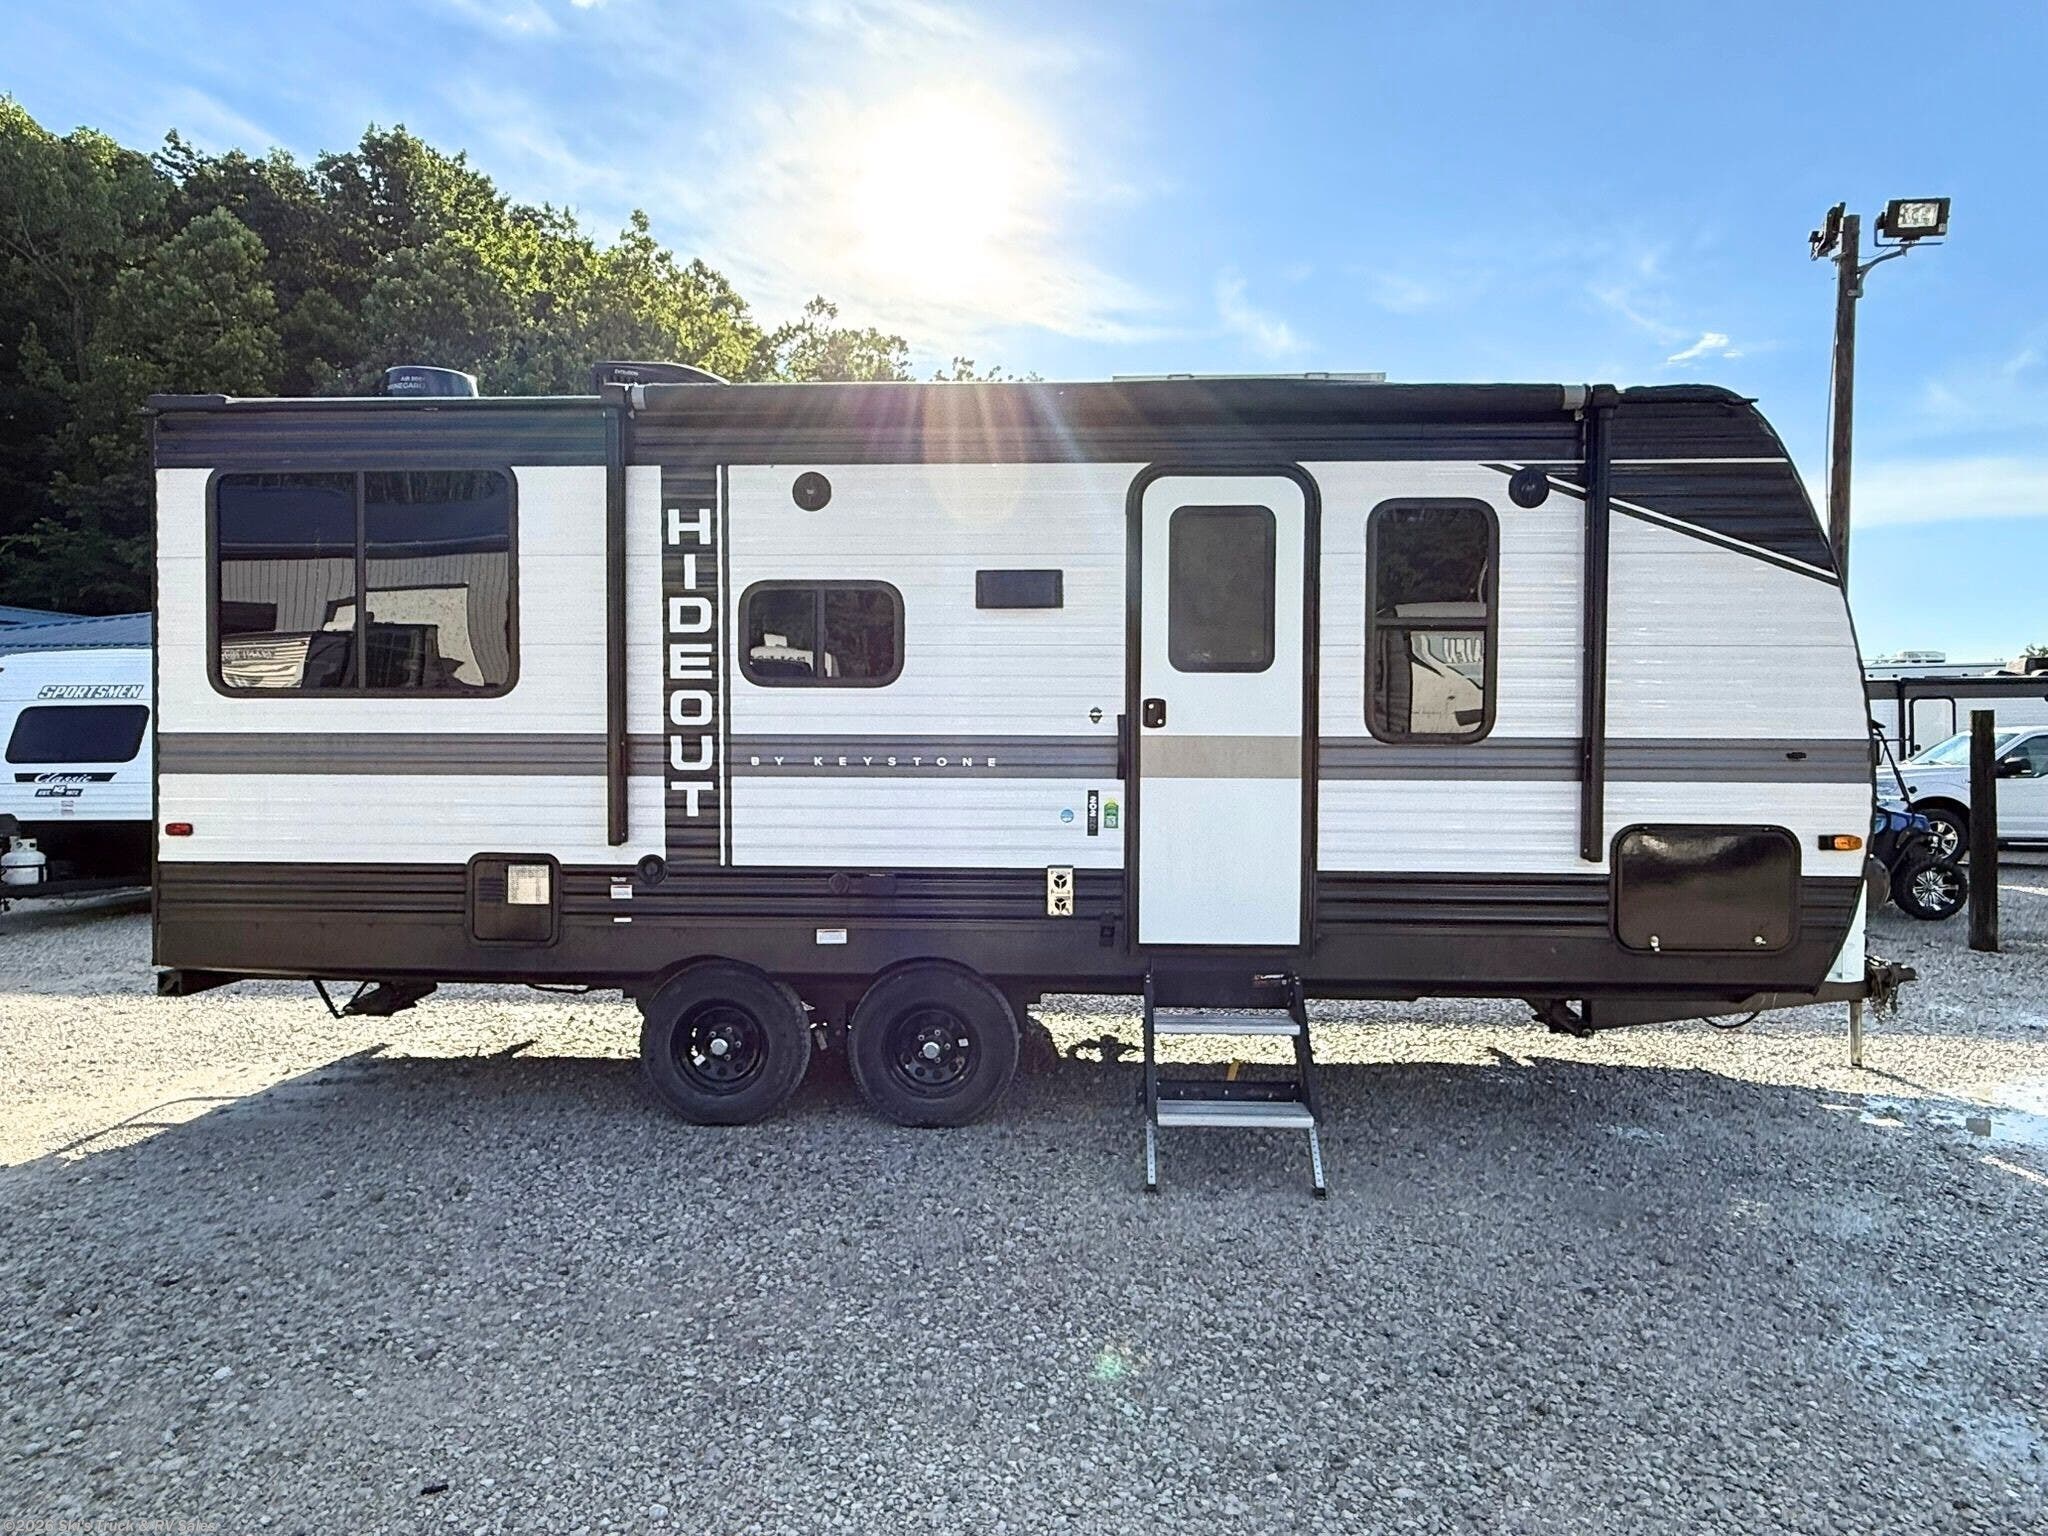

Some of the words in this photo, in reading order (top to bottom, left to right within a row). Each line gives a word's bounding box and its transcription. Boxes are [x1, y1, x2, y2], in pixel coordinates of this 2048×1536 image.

[667, 508, 714, 817] HIDEOUT
[38, 684, 144, 700] SPORTSMEN
[751, 756, 785, 767] BY
[814, 756, 996, 767] KEYSTONE
[34, 772, 92, 784] Classic
